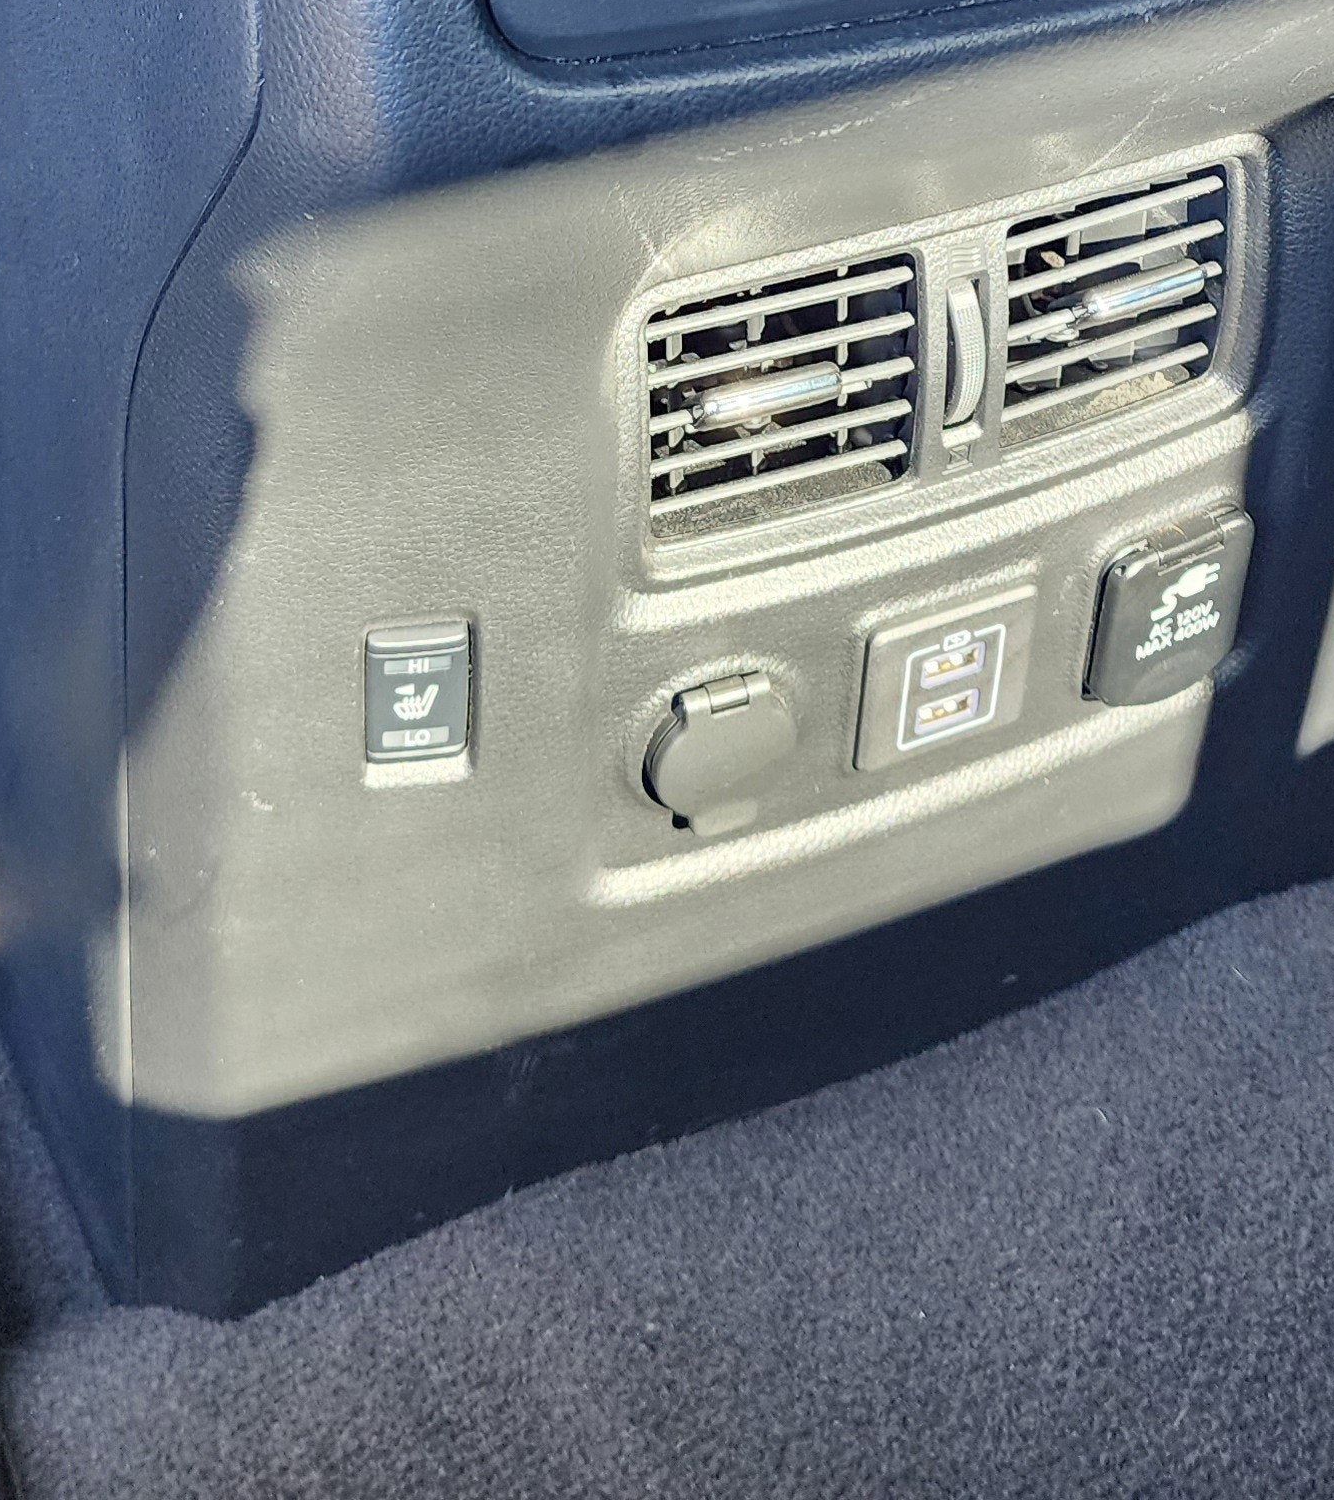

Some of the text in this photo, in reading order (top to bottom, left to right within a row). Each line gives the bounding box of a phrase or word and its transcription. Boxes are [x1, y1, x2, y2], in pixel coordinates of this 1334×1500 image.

[1149, 599, 1214, 641] AC 120V
[1135, 611, 1221, 661] MAX 400W
[407, 656, 430, 674] HI
[403, 729, 432, 747] LO
